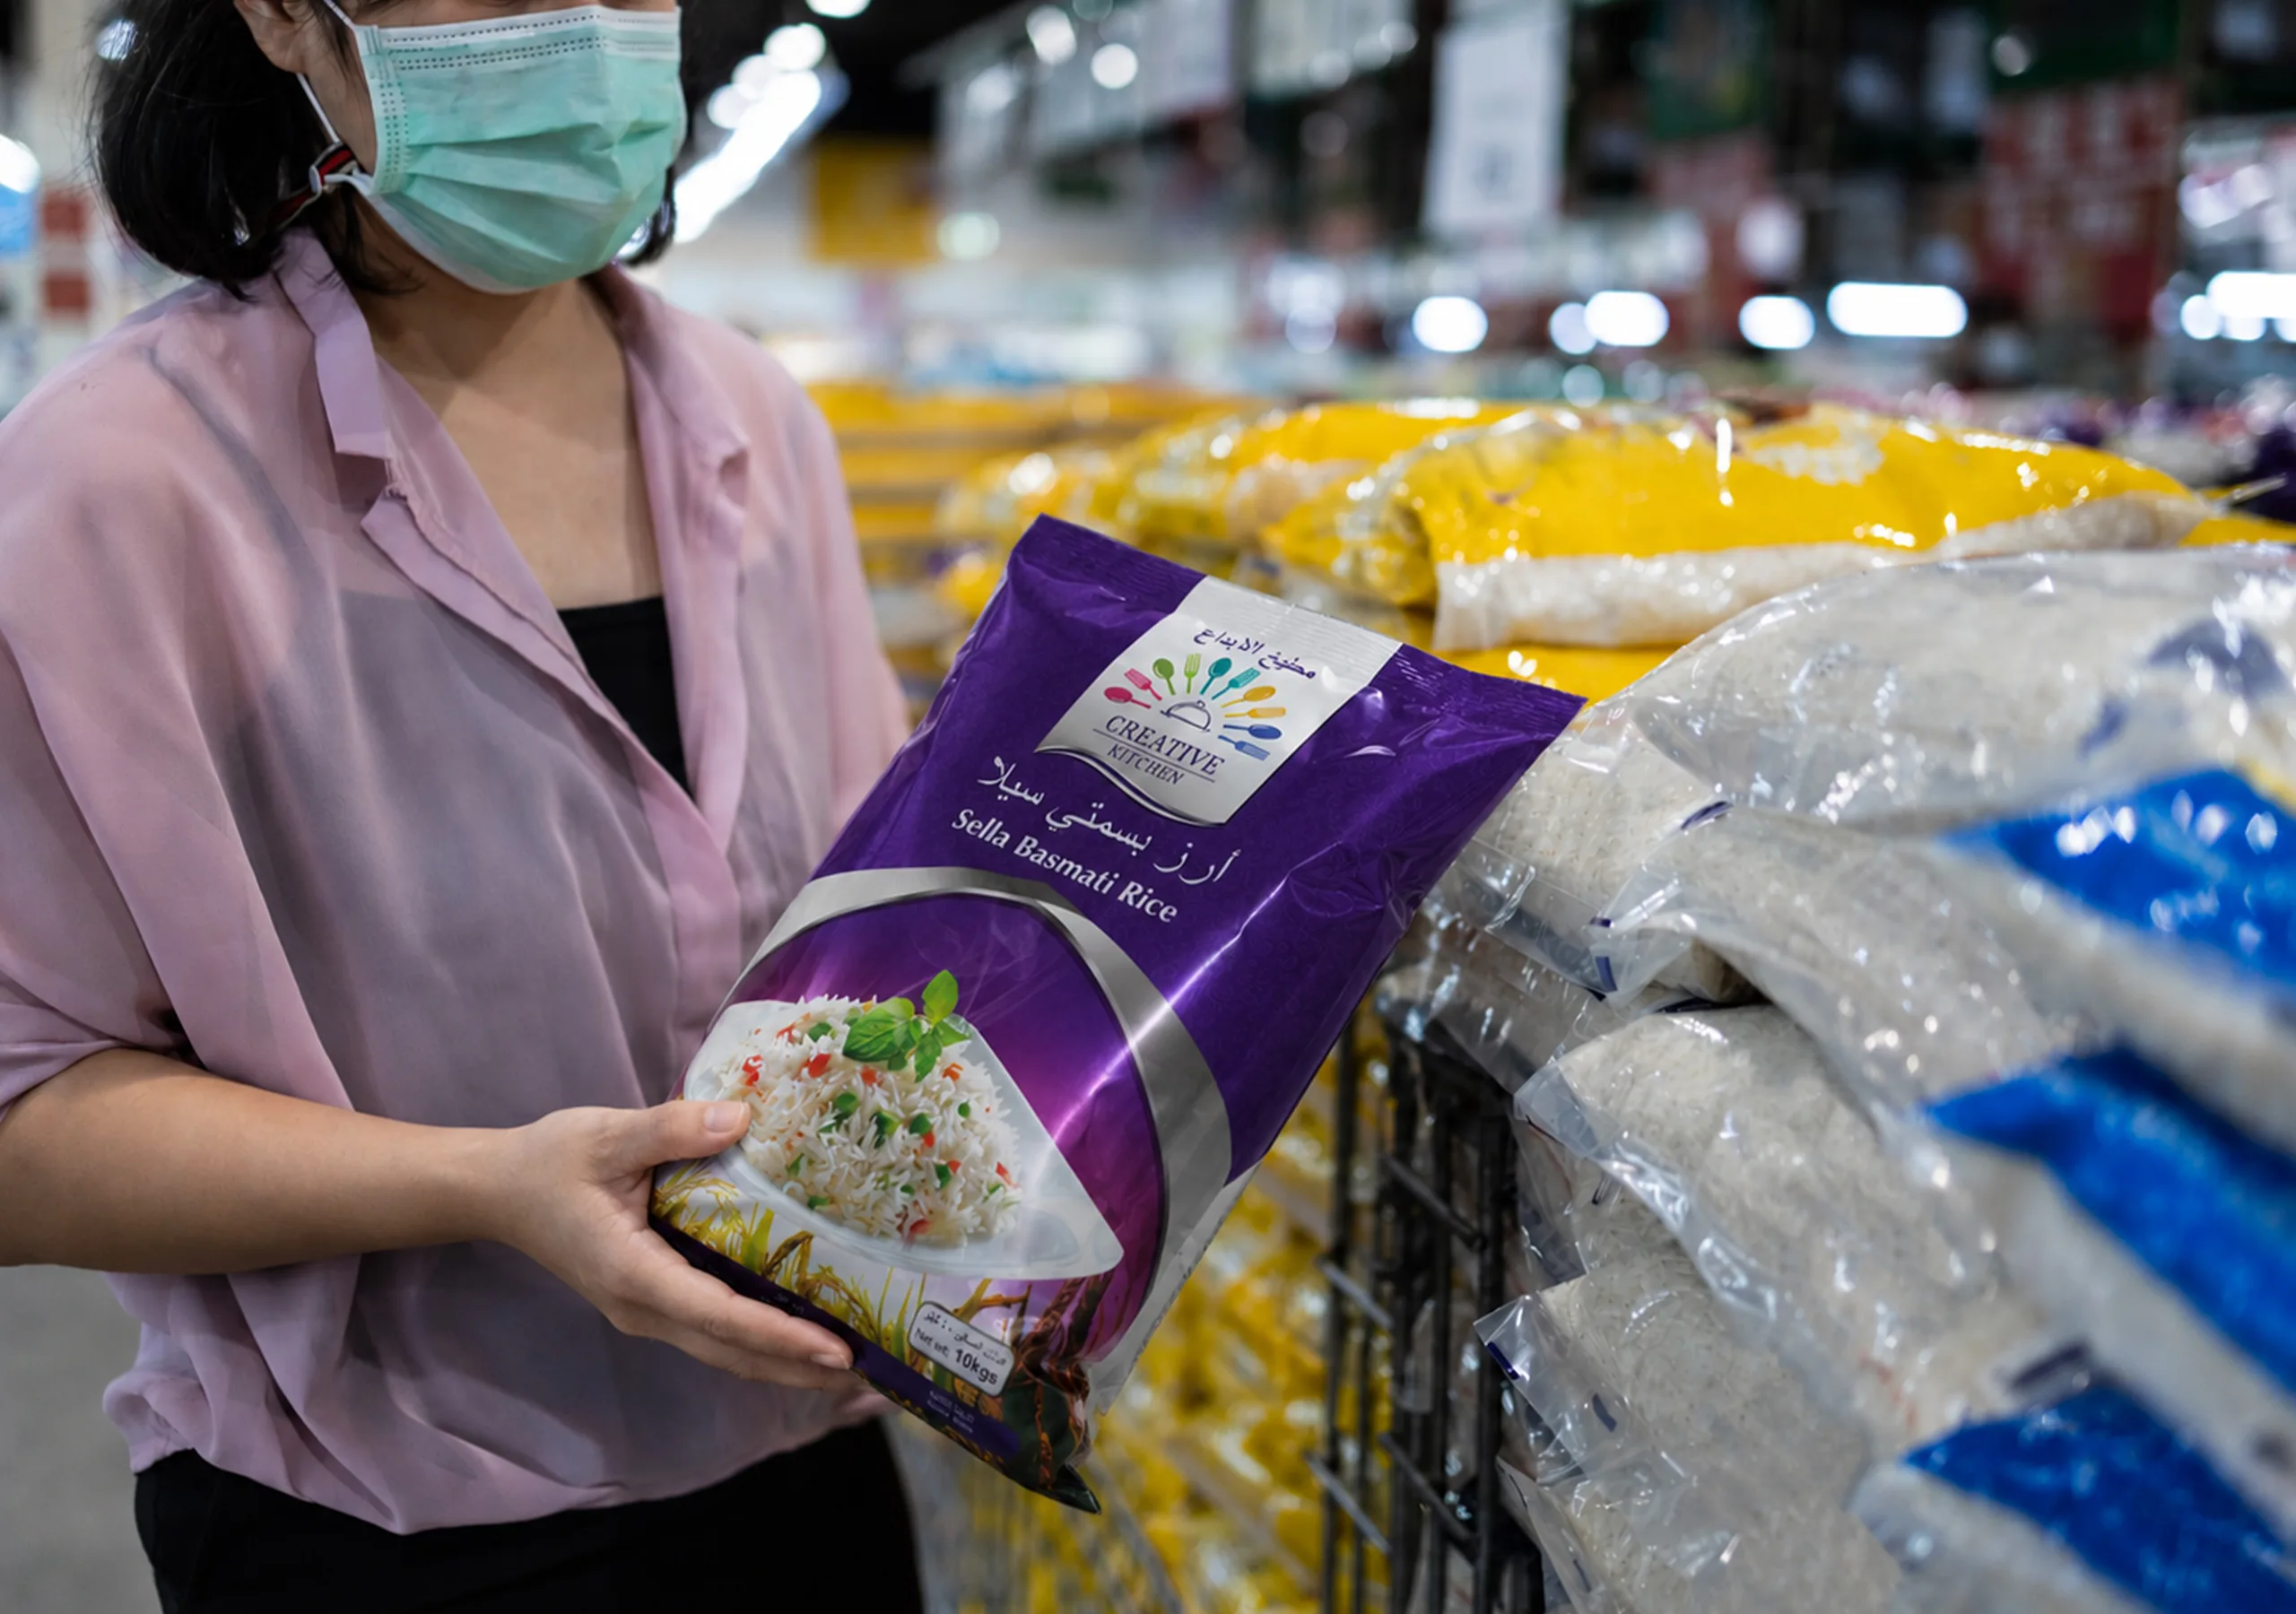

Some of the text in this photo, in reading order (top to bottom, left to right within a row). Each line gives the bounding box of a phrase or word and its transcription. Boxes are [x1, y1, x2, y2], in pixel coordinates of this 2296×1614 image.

[1105, 715, 1225, 776] CREATIVE
[1107, 743, 1185, 785] KITCHEN
[978, 756, 1242, 886] أرز بسمتي سيلا
[952, 808, 1178, 924] Sella Basmati Rice
[955, 1348, 999, 1386] 10kgs
